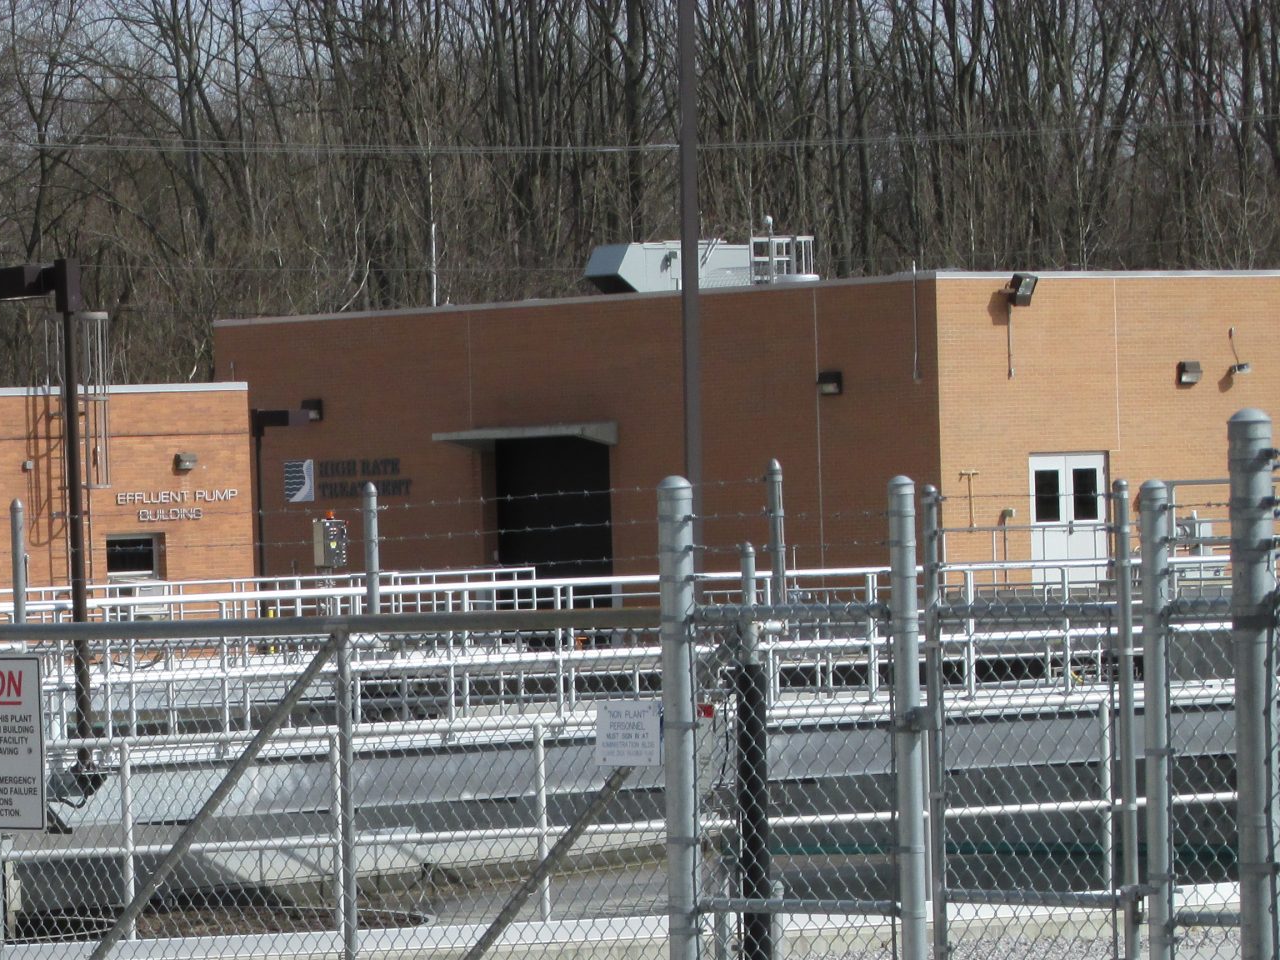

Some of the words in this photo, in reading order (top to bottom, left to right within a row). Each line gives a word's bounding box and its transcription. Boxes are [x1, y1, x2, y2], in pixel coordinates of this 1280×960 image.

[116, 491, 189, 505] EFFLUENT
[195, 489, 237, 502] PUMP
[138, 508, 203, 522] BUILDING
[3, 725, 34, 733] BUILDING
[0, 736, 28, 744] FACILITY
[10, 787, 37, 795] FAILURE
